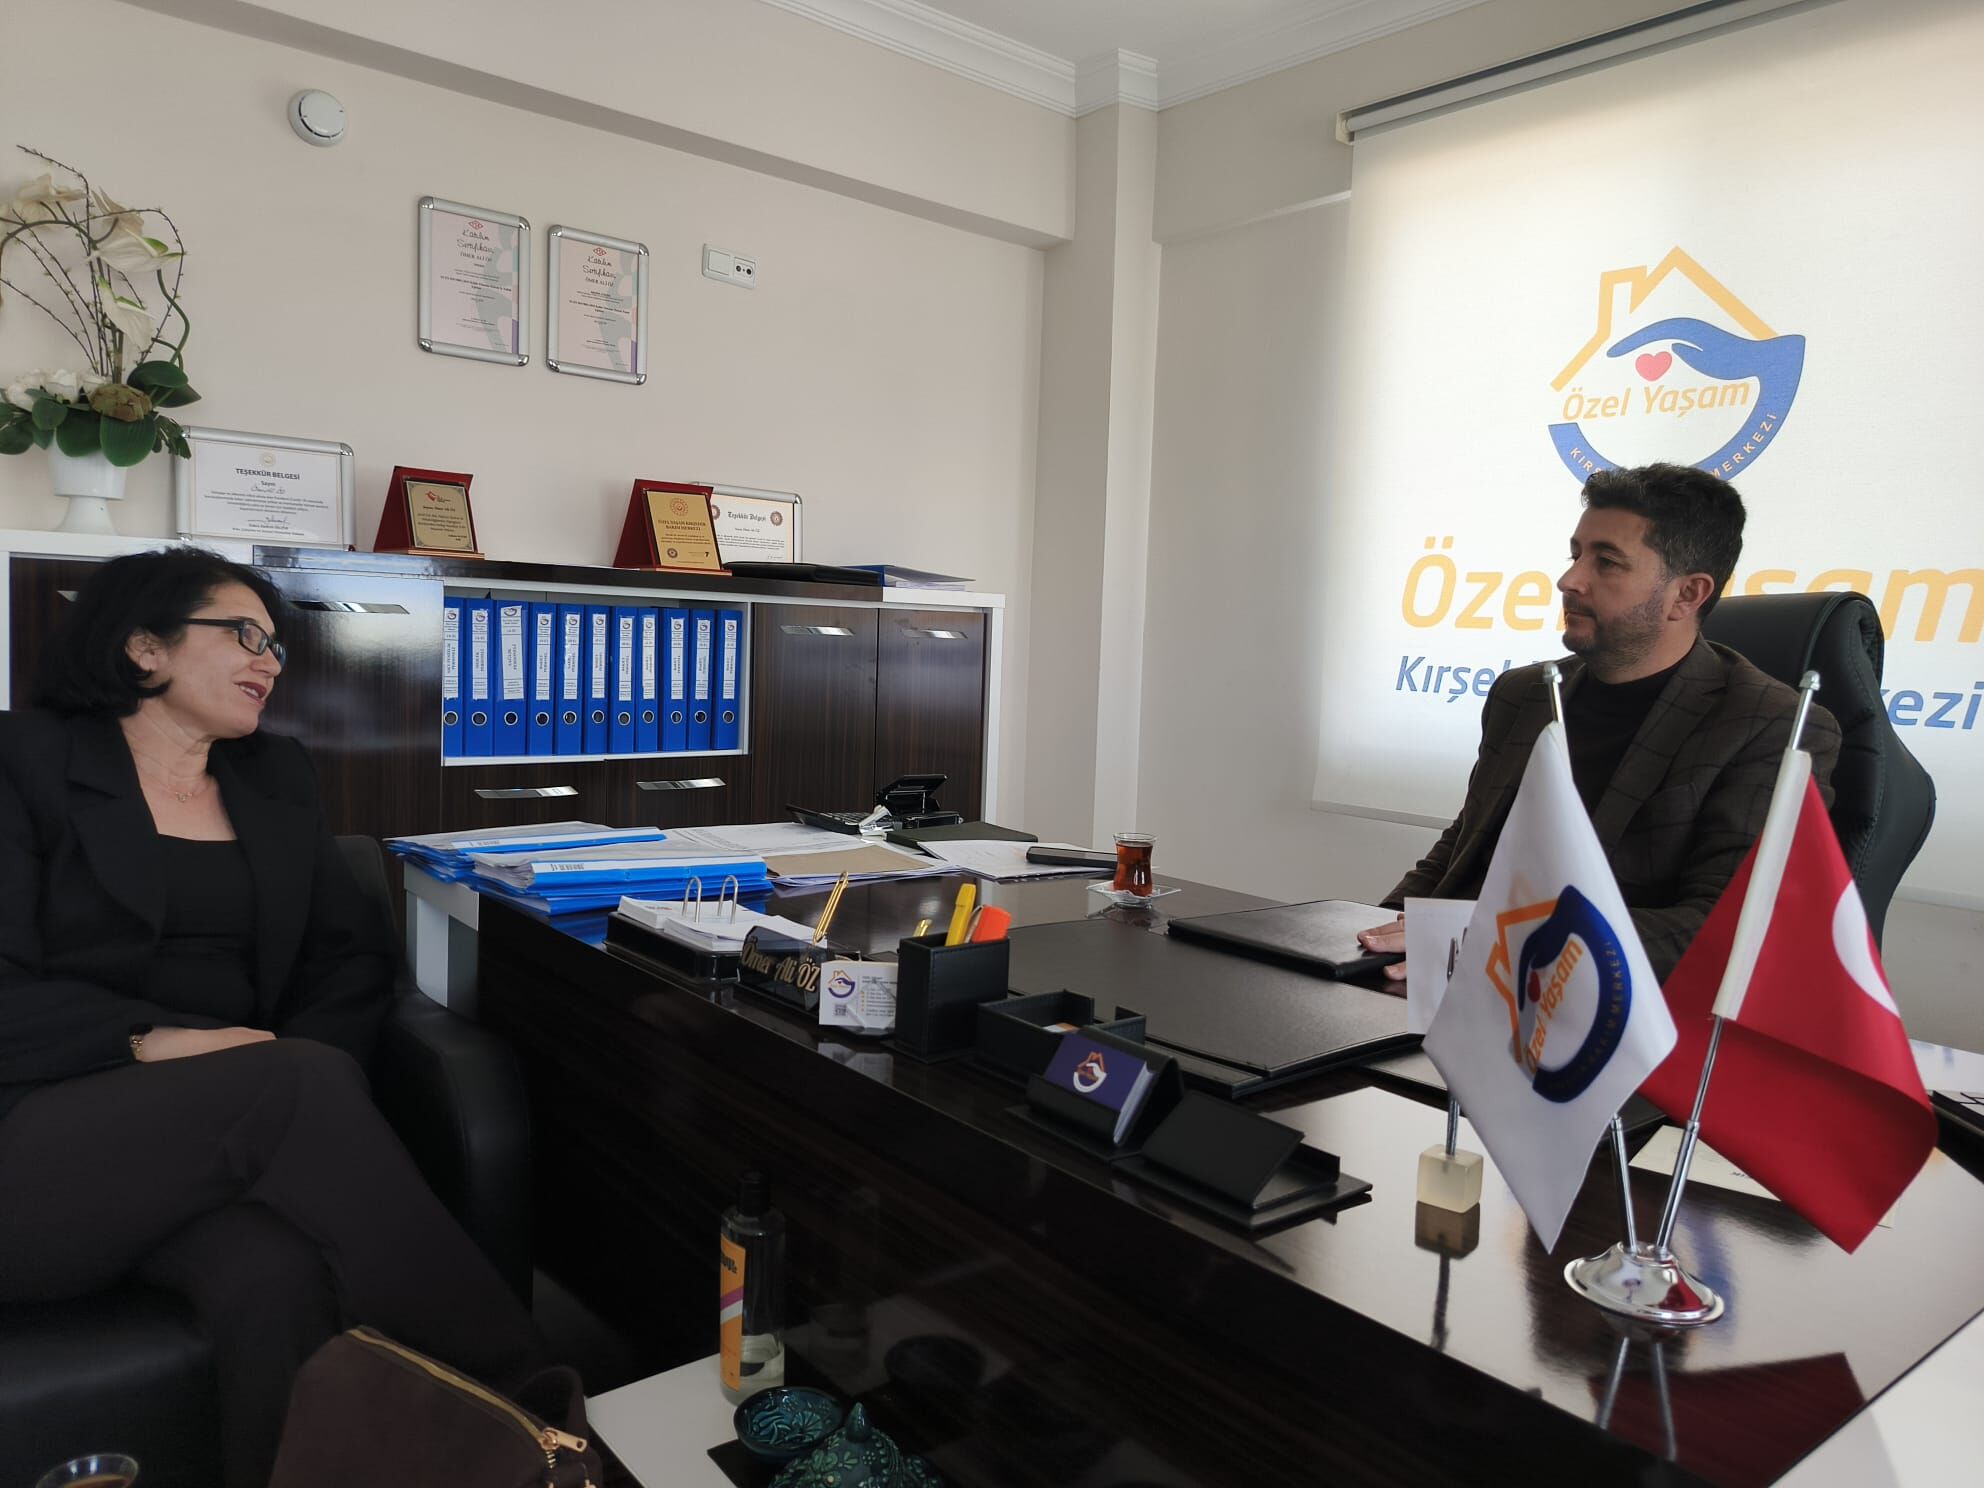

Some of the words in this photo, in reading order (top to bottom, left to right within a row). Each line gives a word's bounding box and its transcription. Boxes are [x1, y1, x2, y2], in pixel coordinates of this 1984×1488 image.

[1562, 387, 1631, 422] Özel
[1644, 382, 1750, 419] Yaşam
[1402, 536, 1567, 631] Öze
[1396, 656, 1511, 703] Kırşe
[774, 956, 797, 983] Ali
[797, 957, 821, 992] ÖZ
